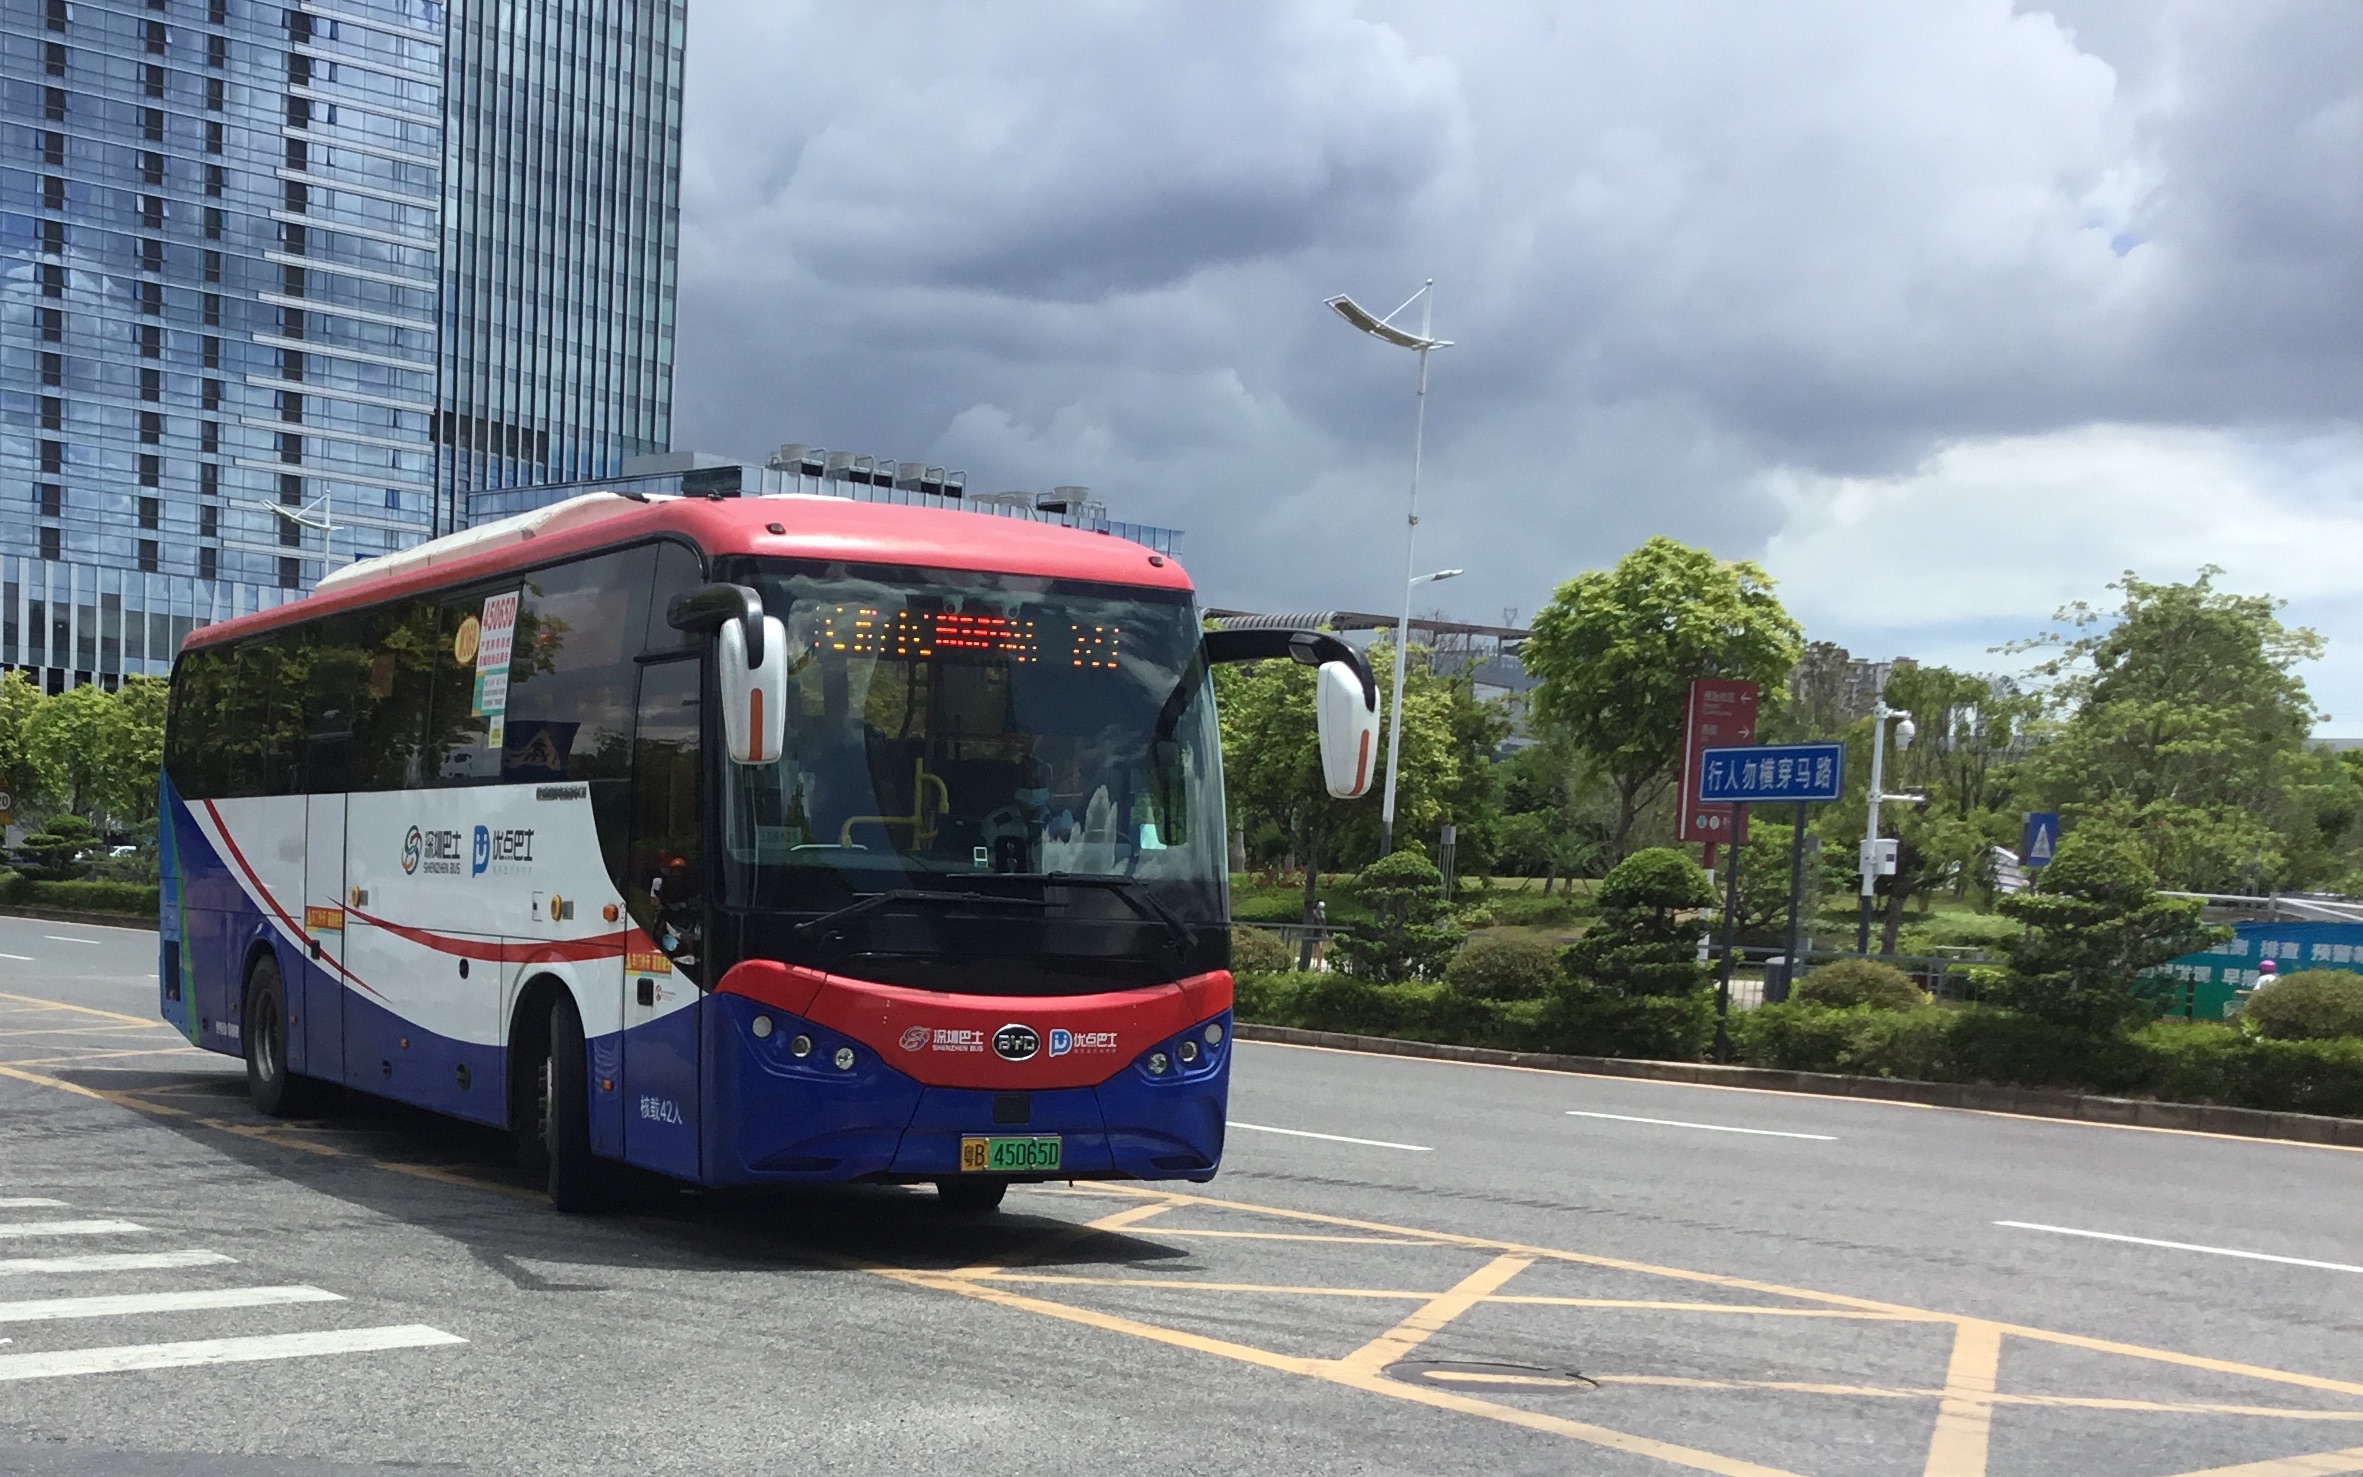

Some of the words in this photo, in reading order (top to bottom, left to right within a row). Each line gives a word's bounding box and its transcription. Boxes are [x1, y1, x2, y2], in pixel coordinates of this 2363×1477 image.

[1707, 756, 1833, 792] 行人勿横穿马路
[424, 830, 462, 860] 深圳巴士
[492, 829, 535, 862] 优点巴士
[423, 862, 449, 874] SHENZHEN
[450, 862, 461, 875] BUS
[933, 1029, 984, 1044] 深圳巴士
[998, 1034, 1036, 1051] BYD
[1074, 1032, 1118, 1048] 优点巴士
[932, 1044, 968, 1052] SHENZHEN
